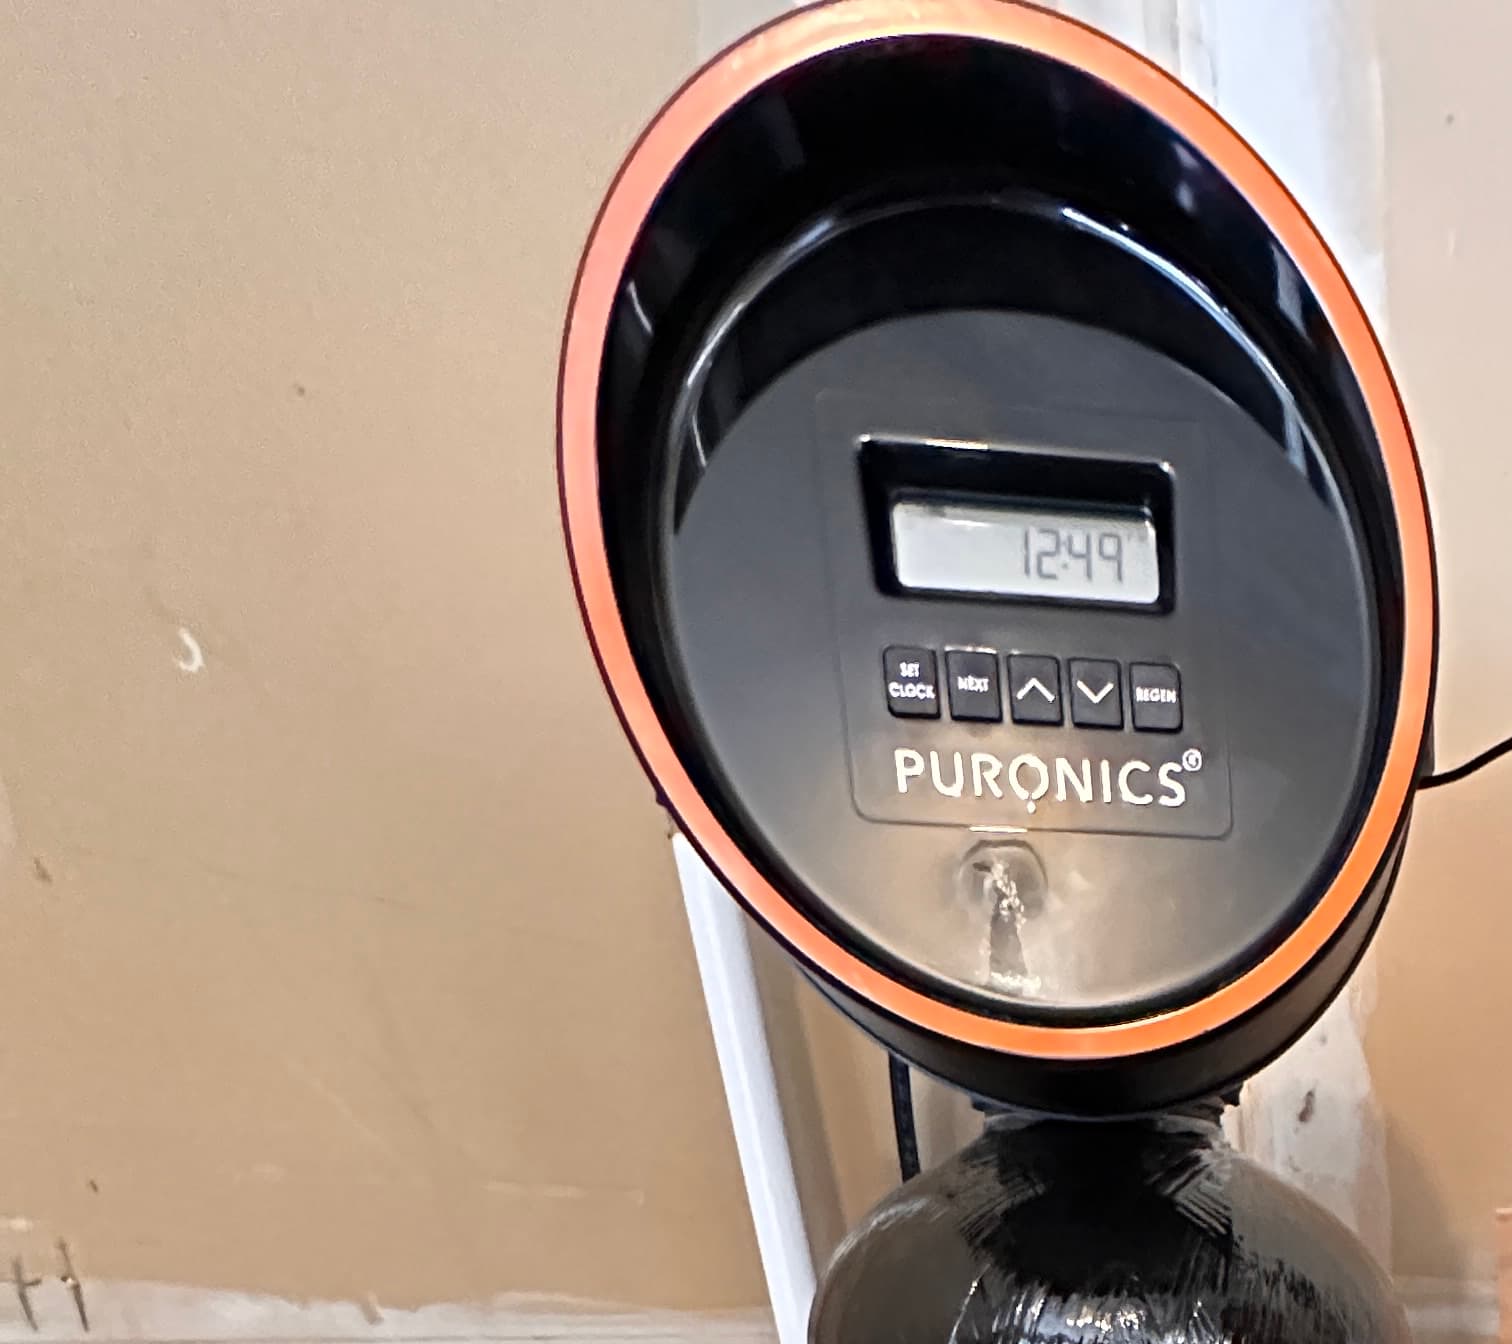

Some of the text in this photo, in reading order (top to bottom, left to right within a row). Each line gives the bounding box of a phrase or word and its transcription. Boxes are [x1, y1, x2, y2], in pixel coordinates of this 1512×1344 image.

[1024, 528, 1122, 582] 12:49
[899, 661, 920, 678] SET
[888, 681, 936, 701] CLOCK
[957, 675, 990, 693] NEXT
[1135, 686, 1177, 703] REGEN
